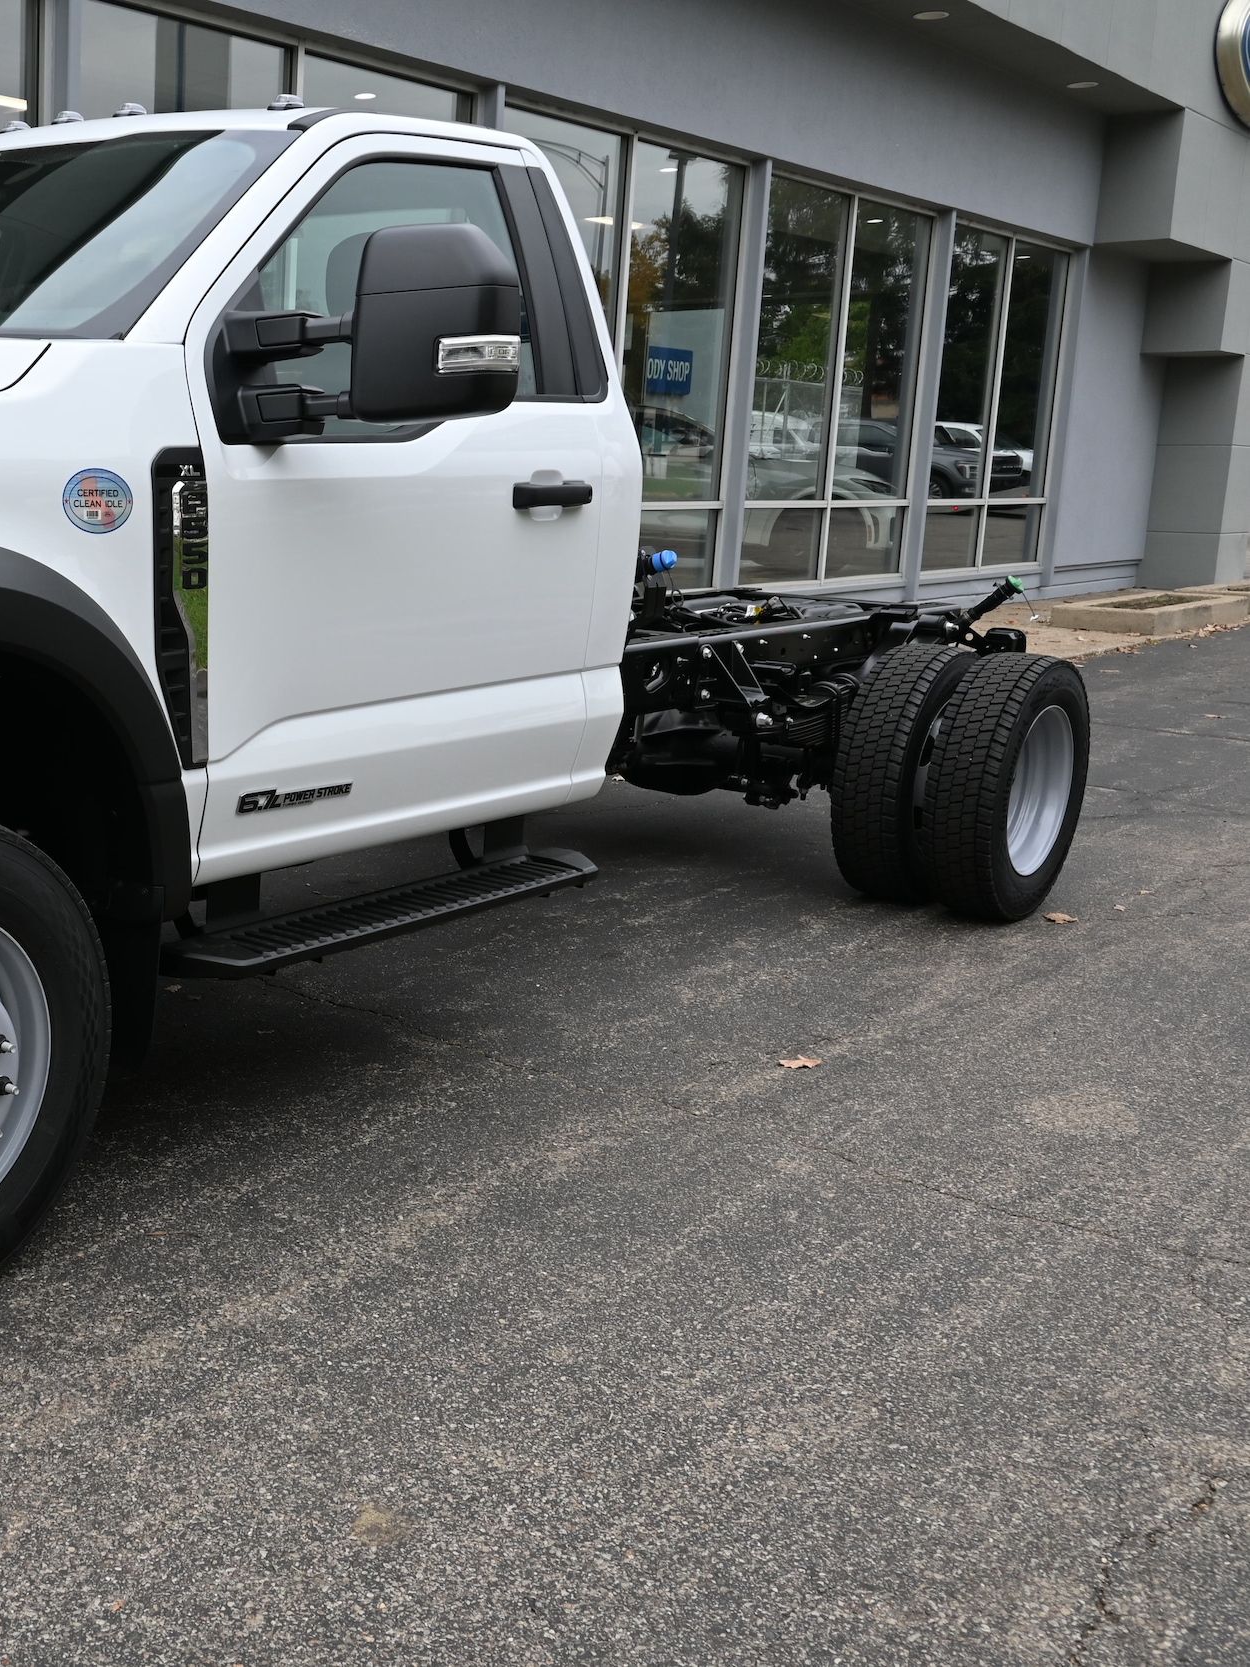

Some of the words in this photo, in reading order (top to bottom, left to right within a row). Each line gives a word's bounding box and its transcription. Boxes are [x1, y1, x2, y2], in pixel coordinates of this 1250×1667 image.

[647, 358, 665, 380] ODY
[667, 360, 690, 382] SHOP
[179, 464, 201, 477] XL
[77, 488, 119, 498] CERTIFIED
[73, 499, 102, 508] CLEAN
[105, 499, 123, 508] IDLE
[238, 789, 281, 813] 6.7L
[283, 789, 315, 803] POWER
[316, 783, 352, 797] STROKE
